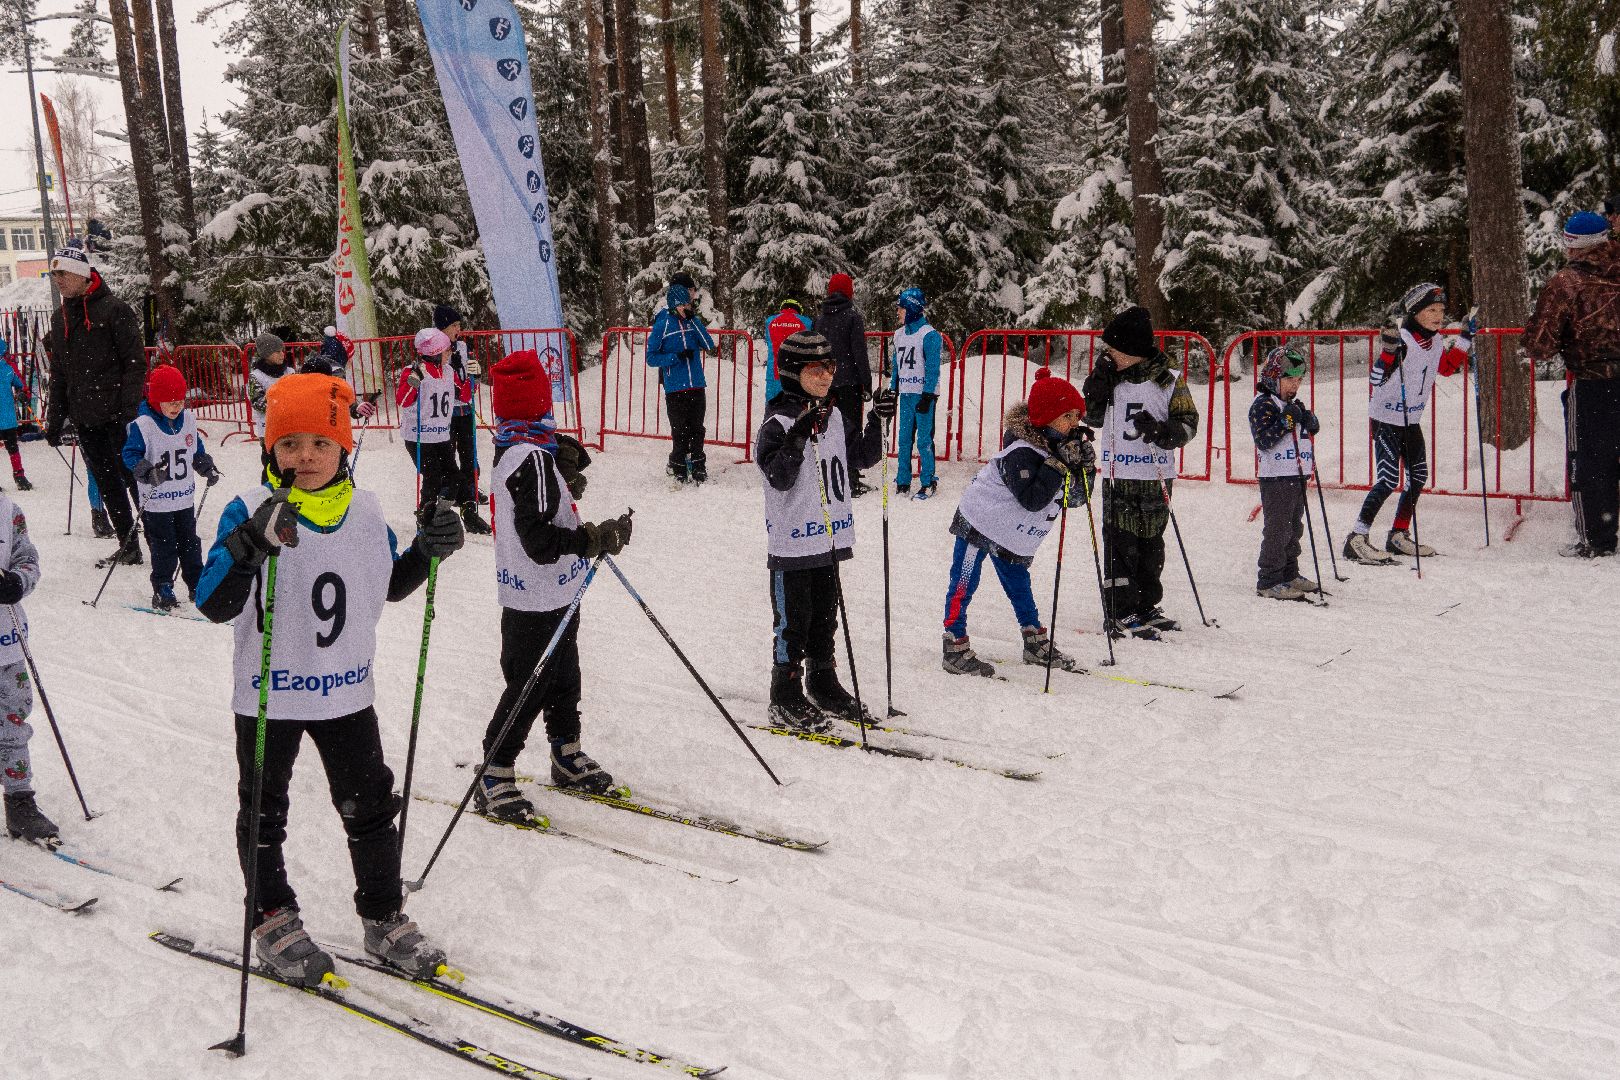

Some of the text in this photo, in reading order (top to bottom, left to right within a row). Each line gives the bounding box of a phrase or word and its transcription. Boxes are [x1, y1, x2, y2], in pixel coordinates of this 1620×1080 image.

[898, 346, 916, 369] 74
[1418, 365, 1428, 396] 1
[430, 391, 450, 418] 16
[1123, 403, 1145, 441] 5
[160, 449, 188, 481] 15
[821, 455, 845, 504] 10
[311, 571, 347, 648] 9
